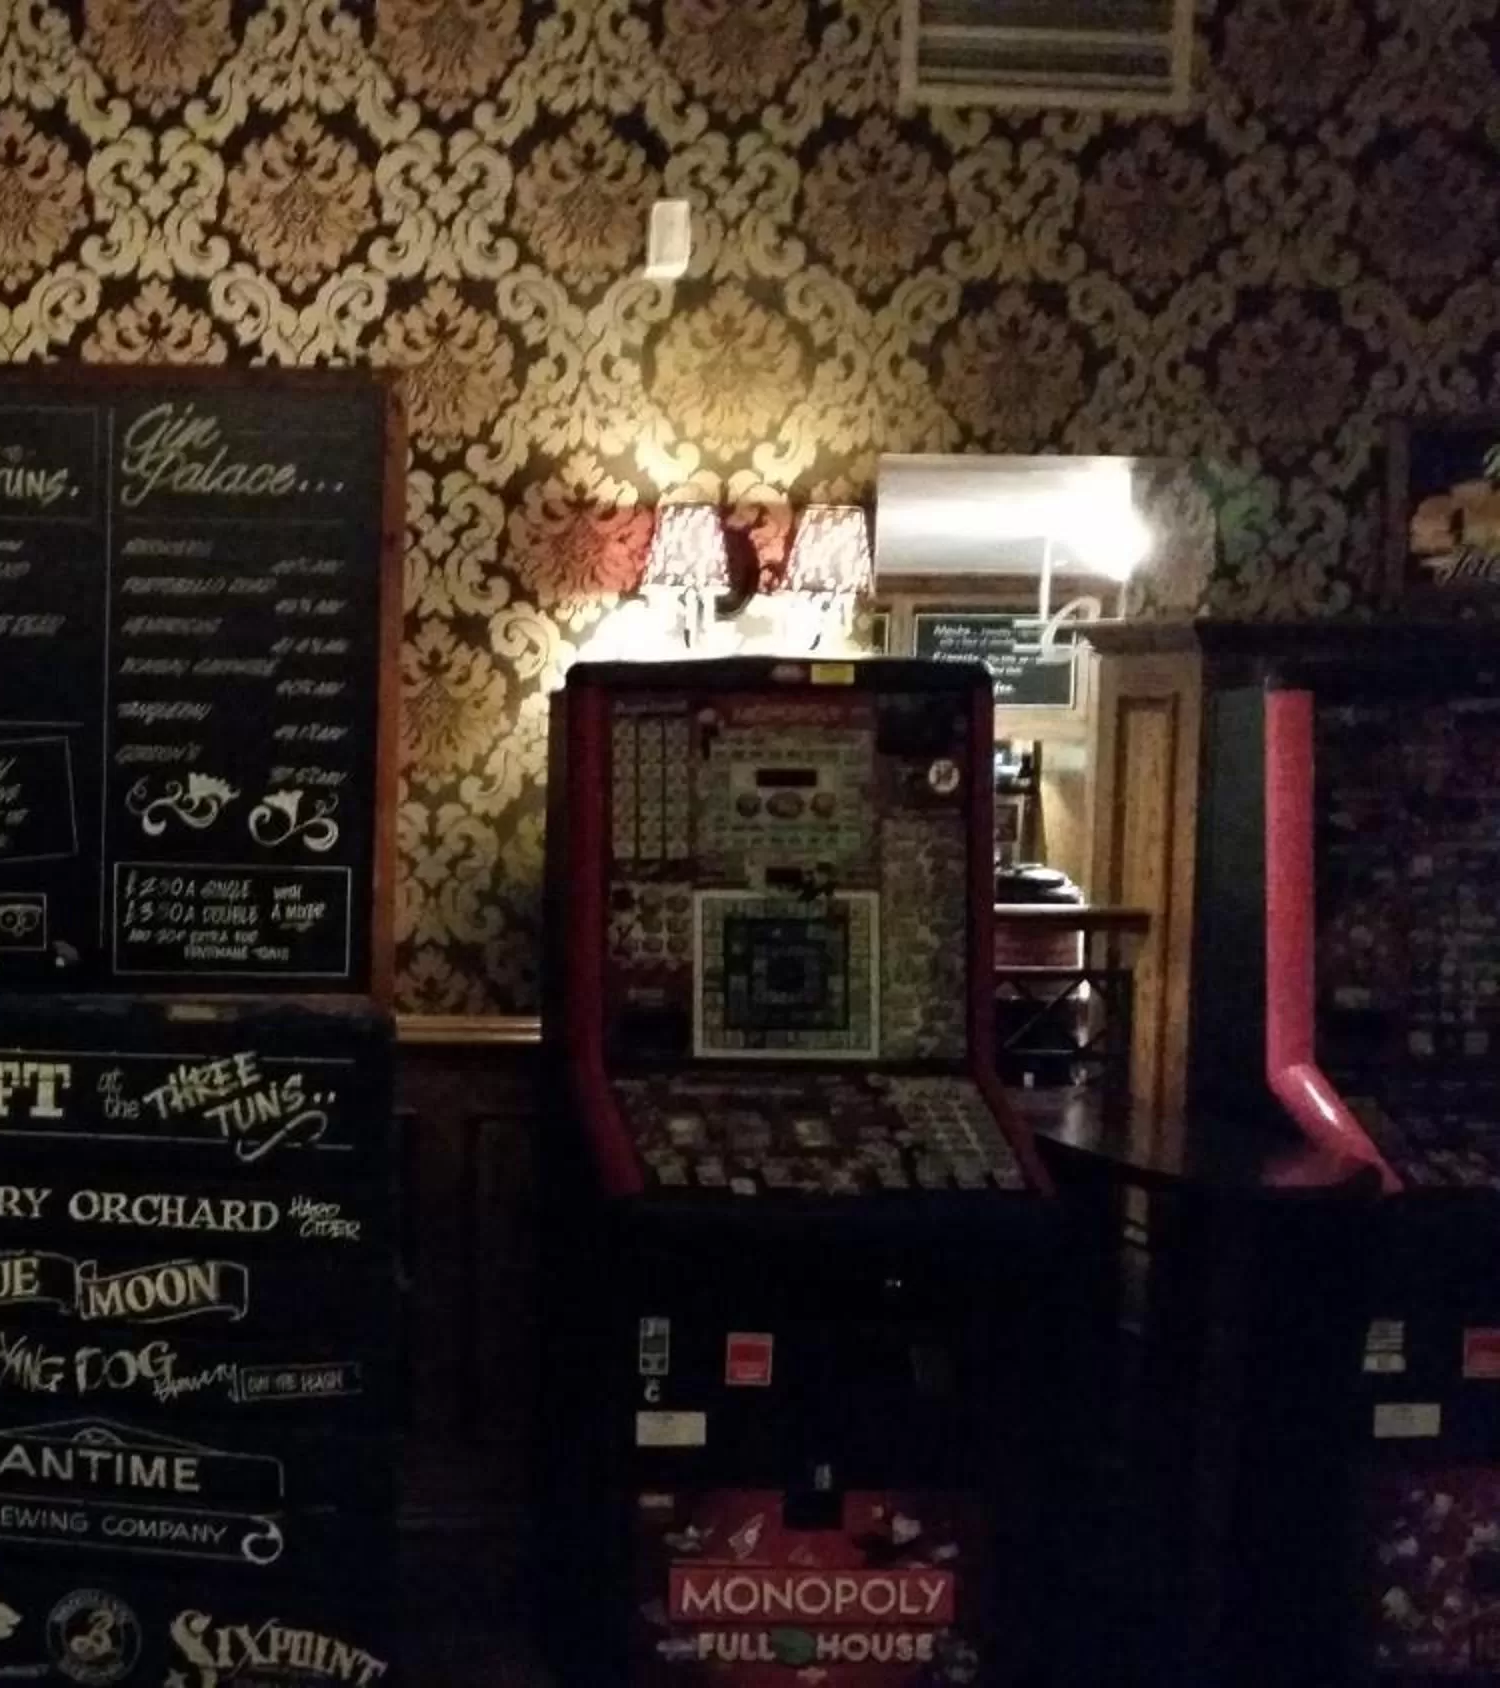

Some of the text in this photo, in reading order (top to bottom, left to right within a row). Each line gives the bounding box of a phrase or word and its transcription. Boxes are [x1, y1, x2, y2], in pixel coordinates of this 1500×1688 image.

[121, 402, 223, 474] Gin
[141, 1050, 263, 1120] THREE
[68, 1189, 281, 1233] ORCHARD
[299, 1218, 361, 1242] CIDER
[88, 1262, 220, 1316] MOON
[75, 1341, 177, 1394] DOG
[102, 1514, 227, 1545] COMPANY
[681, 1575, 946, 1614] MONOPOLY
[698, 1632, 934, 1661] FULL HOUSE
